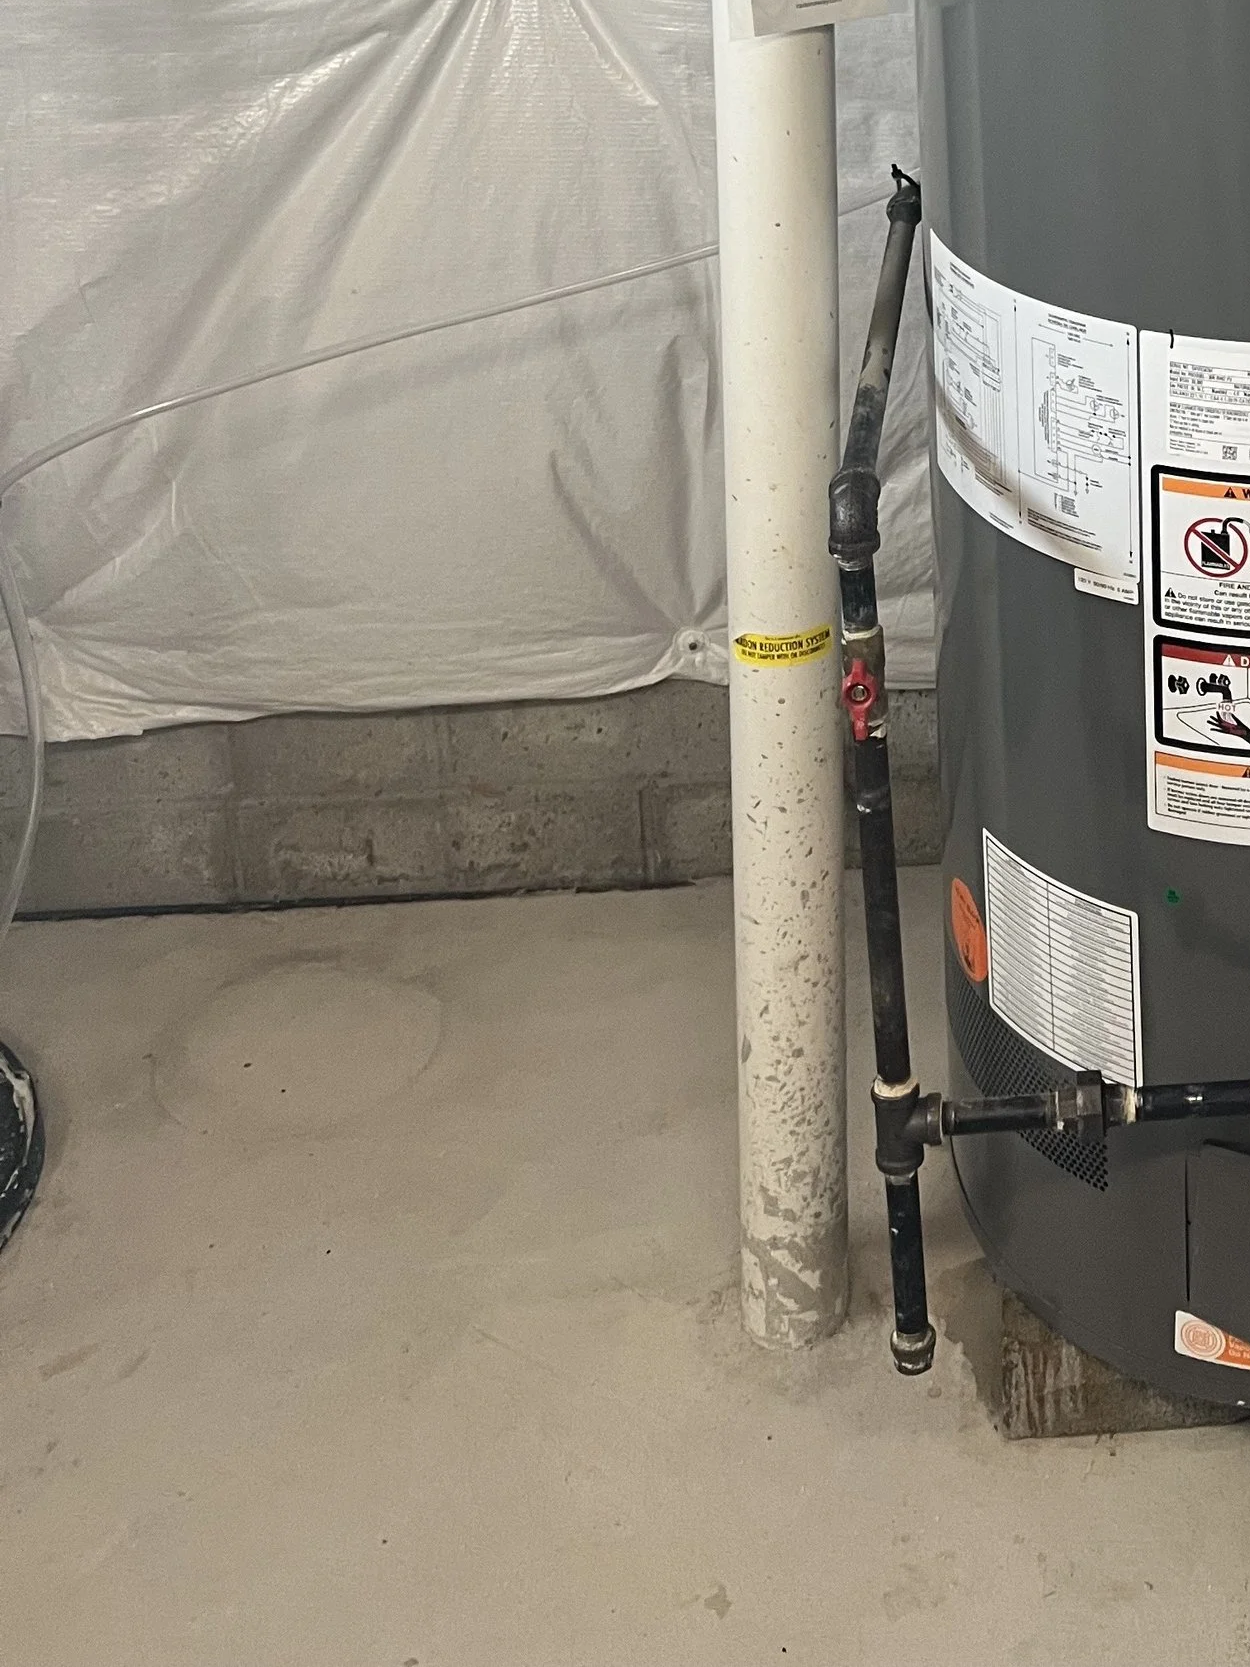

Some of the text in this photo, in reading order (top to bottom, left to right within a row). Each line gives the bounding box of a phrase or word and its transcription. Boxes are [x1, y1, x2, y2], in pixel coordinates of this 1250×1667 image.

[759, 640, 804, 652] REDUCTION
[806, 628, 830, 647] SYSTEM
[1218, 703, 1236, 712] HOT
